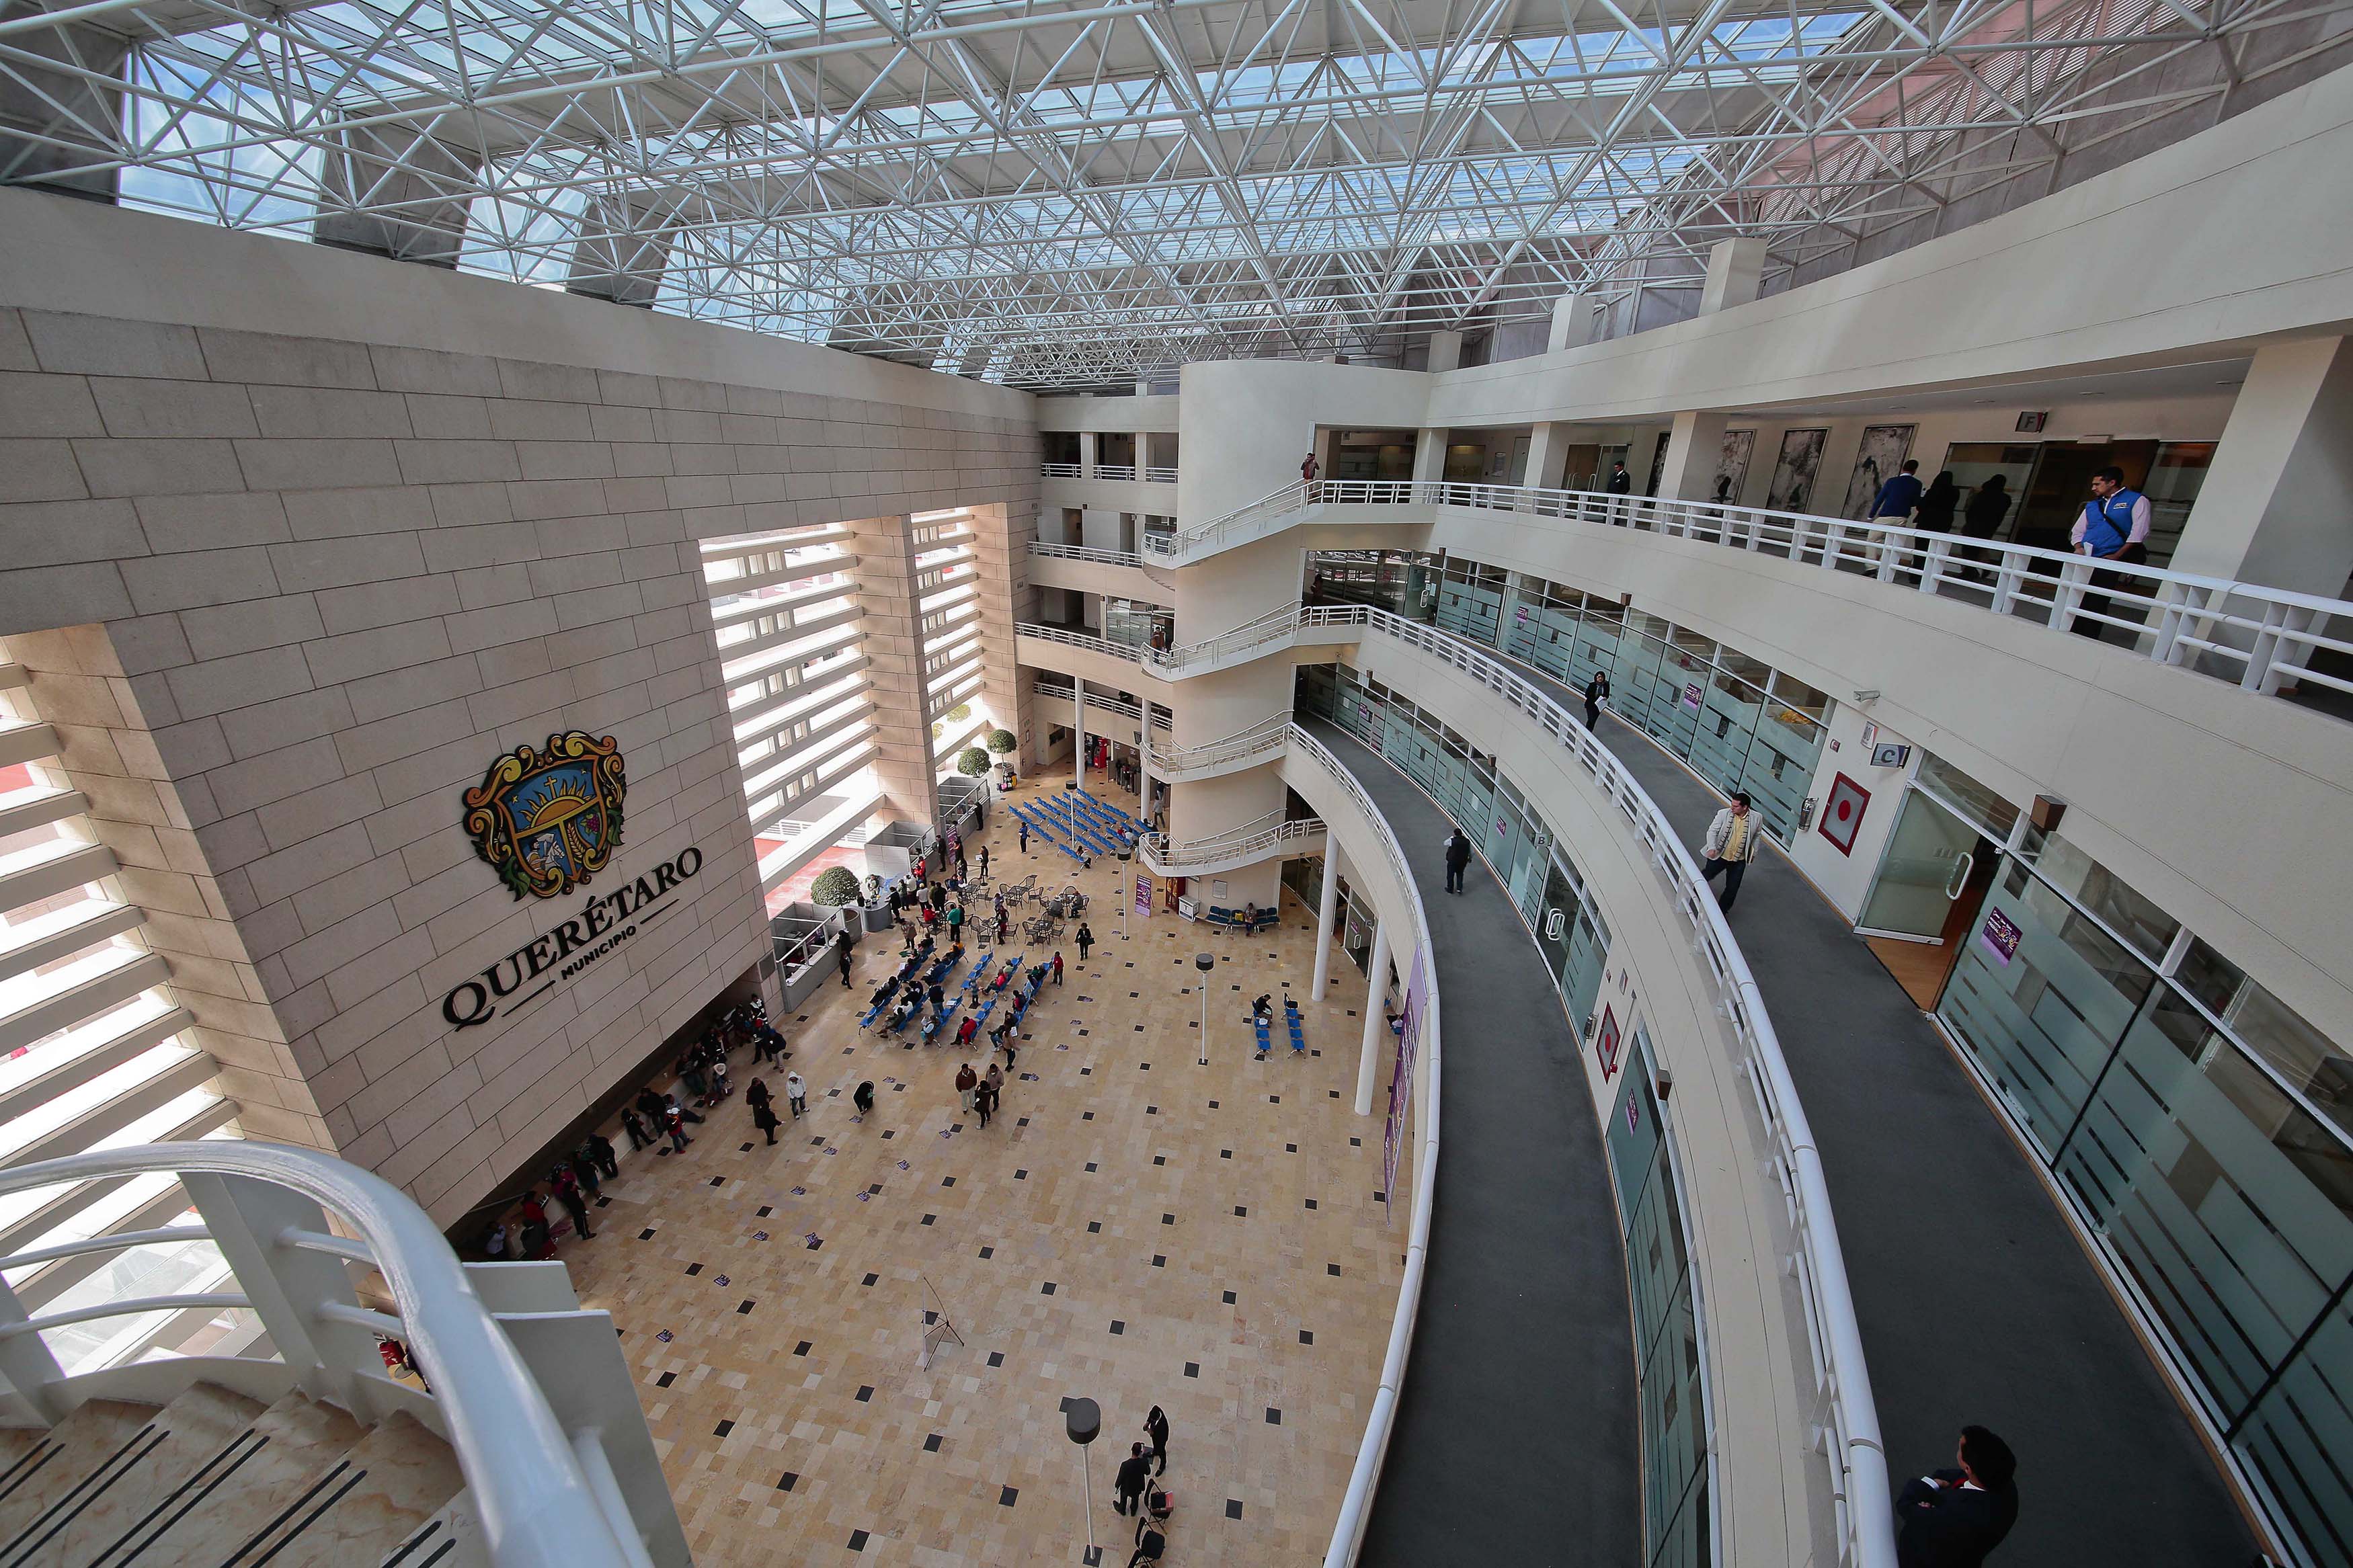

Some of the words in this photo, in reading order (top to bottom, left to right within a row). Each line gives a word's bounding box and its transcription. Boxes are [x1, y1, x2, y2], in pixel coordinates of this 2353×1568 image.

[2024, 416, 2036, 429] F
[1881, 749, 1896, 764] C
[1538, 836, 1545, 845] B
[442, 847, 703, 1032] QUERÉTARO
[561, 924, 637, 981] MUNICIPIO
